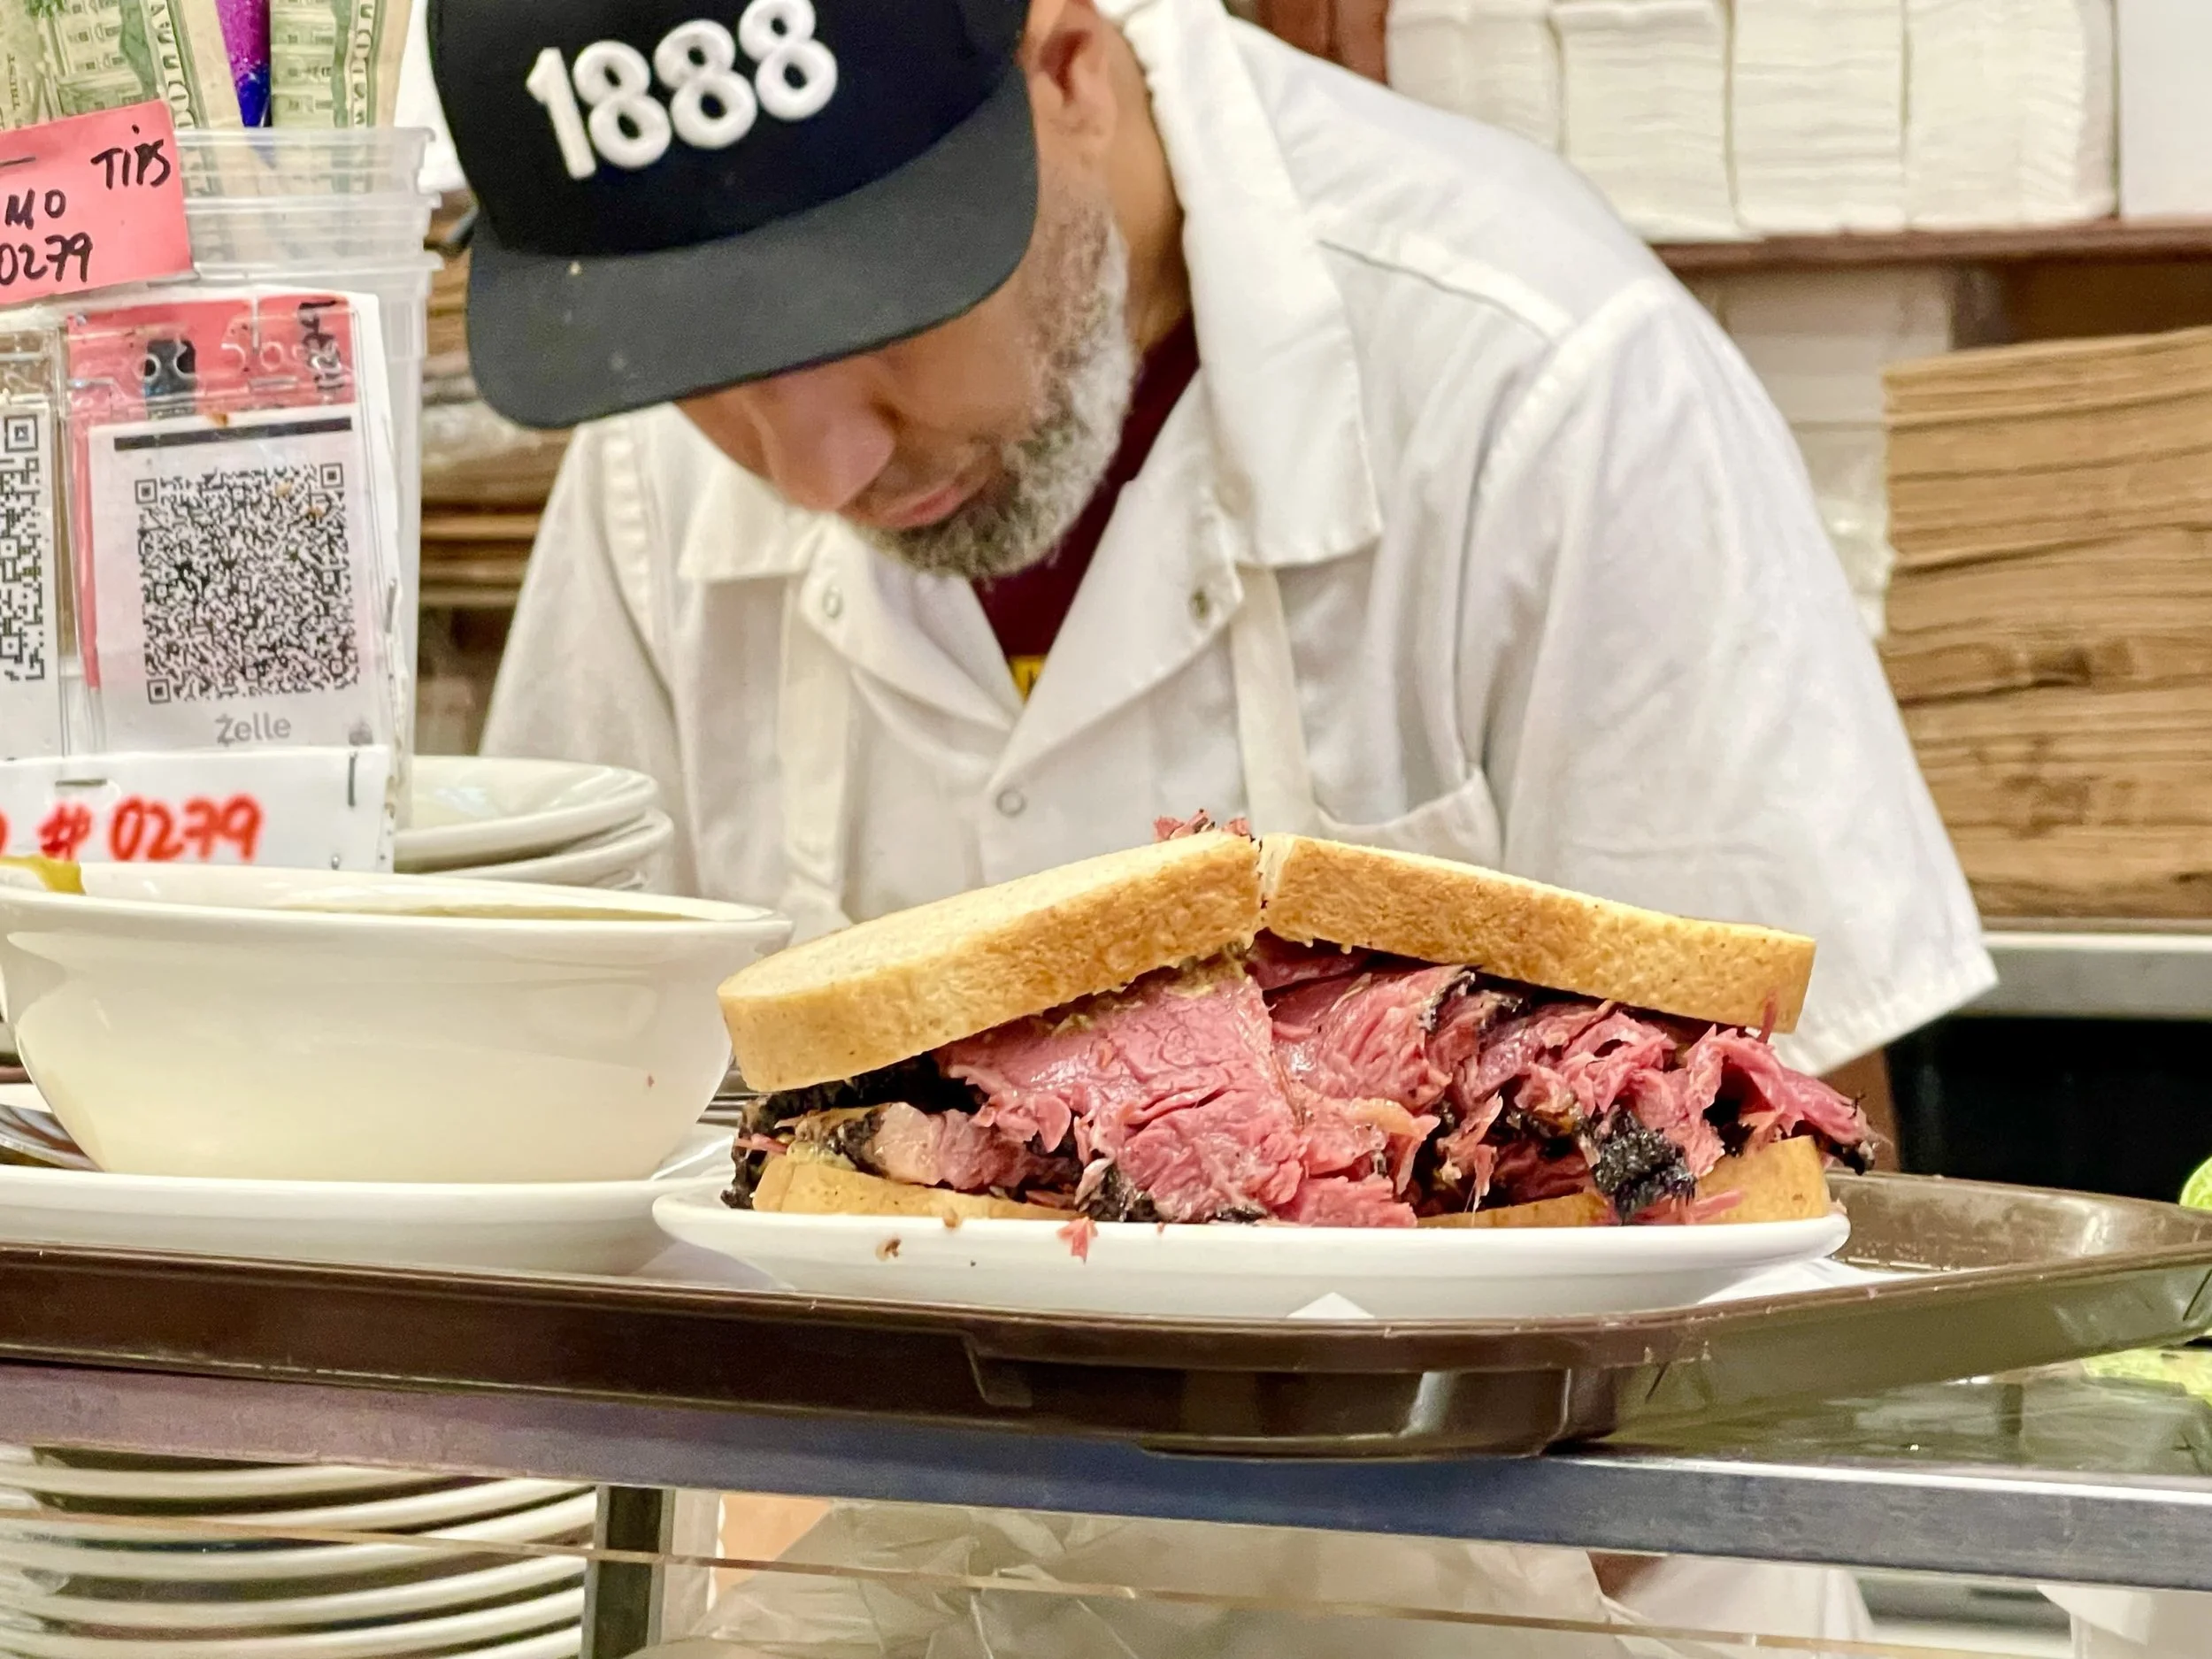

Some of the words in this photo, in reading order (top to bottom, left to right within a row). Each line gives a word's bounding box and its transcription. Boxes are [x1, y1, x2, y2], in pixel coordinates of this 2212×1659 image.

[526, 0, 838, 180] 1888
[90, 125, 172, 190] TIPS
[0, 232, 94, 286] 0279
[214, 712, 291, 747] Zelle
[110, 795, 263, 864] 0279
